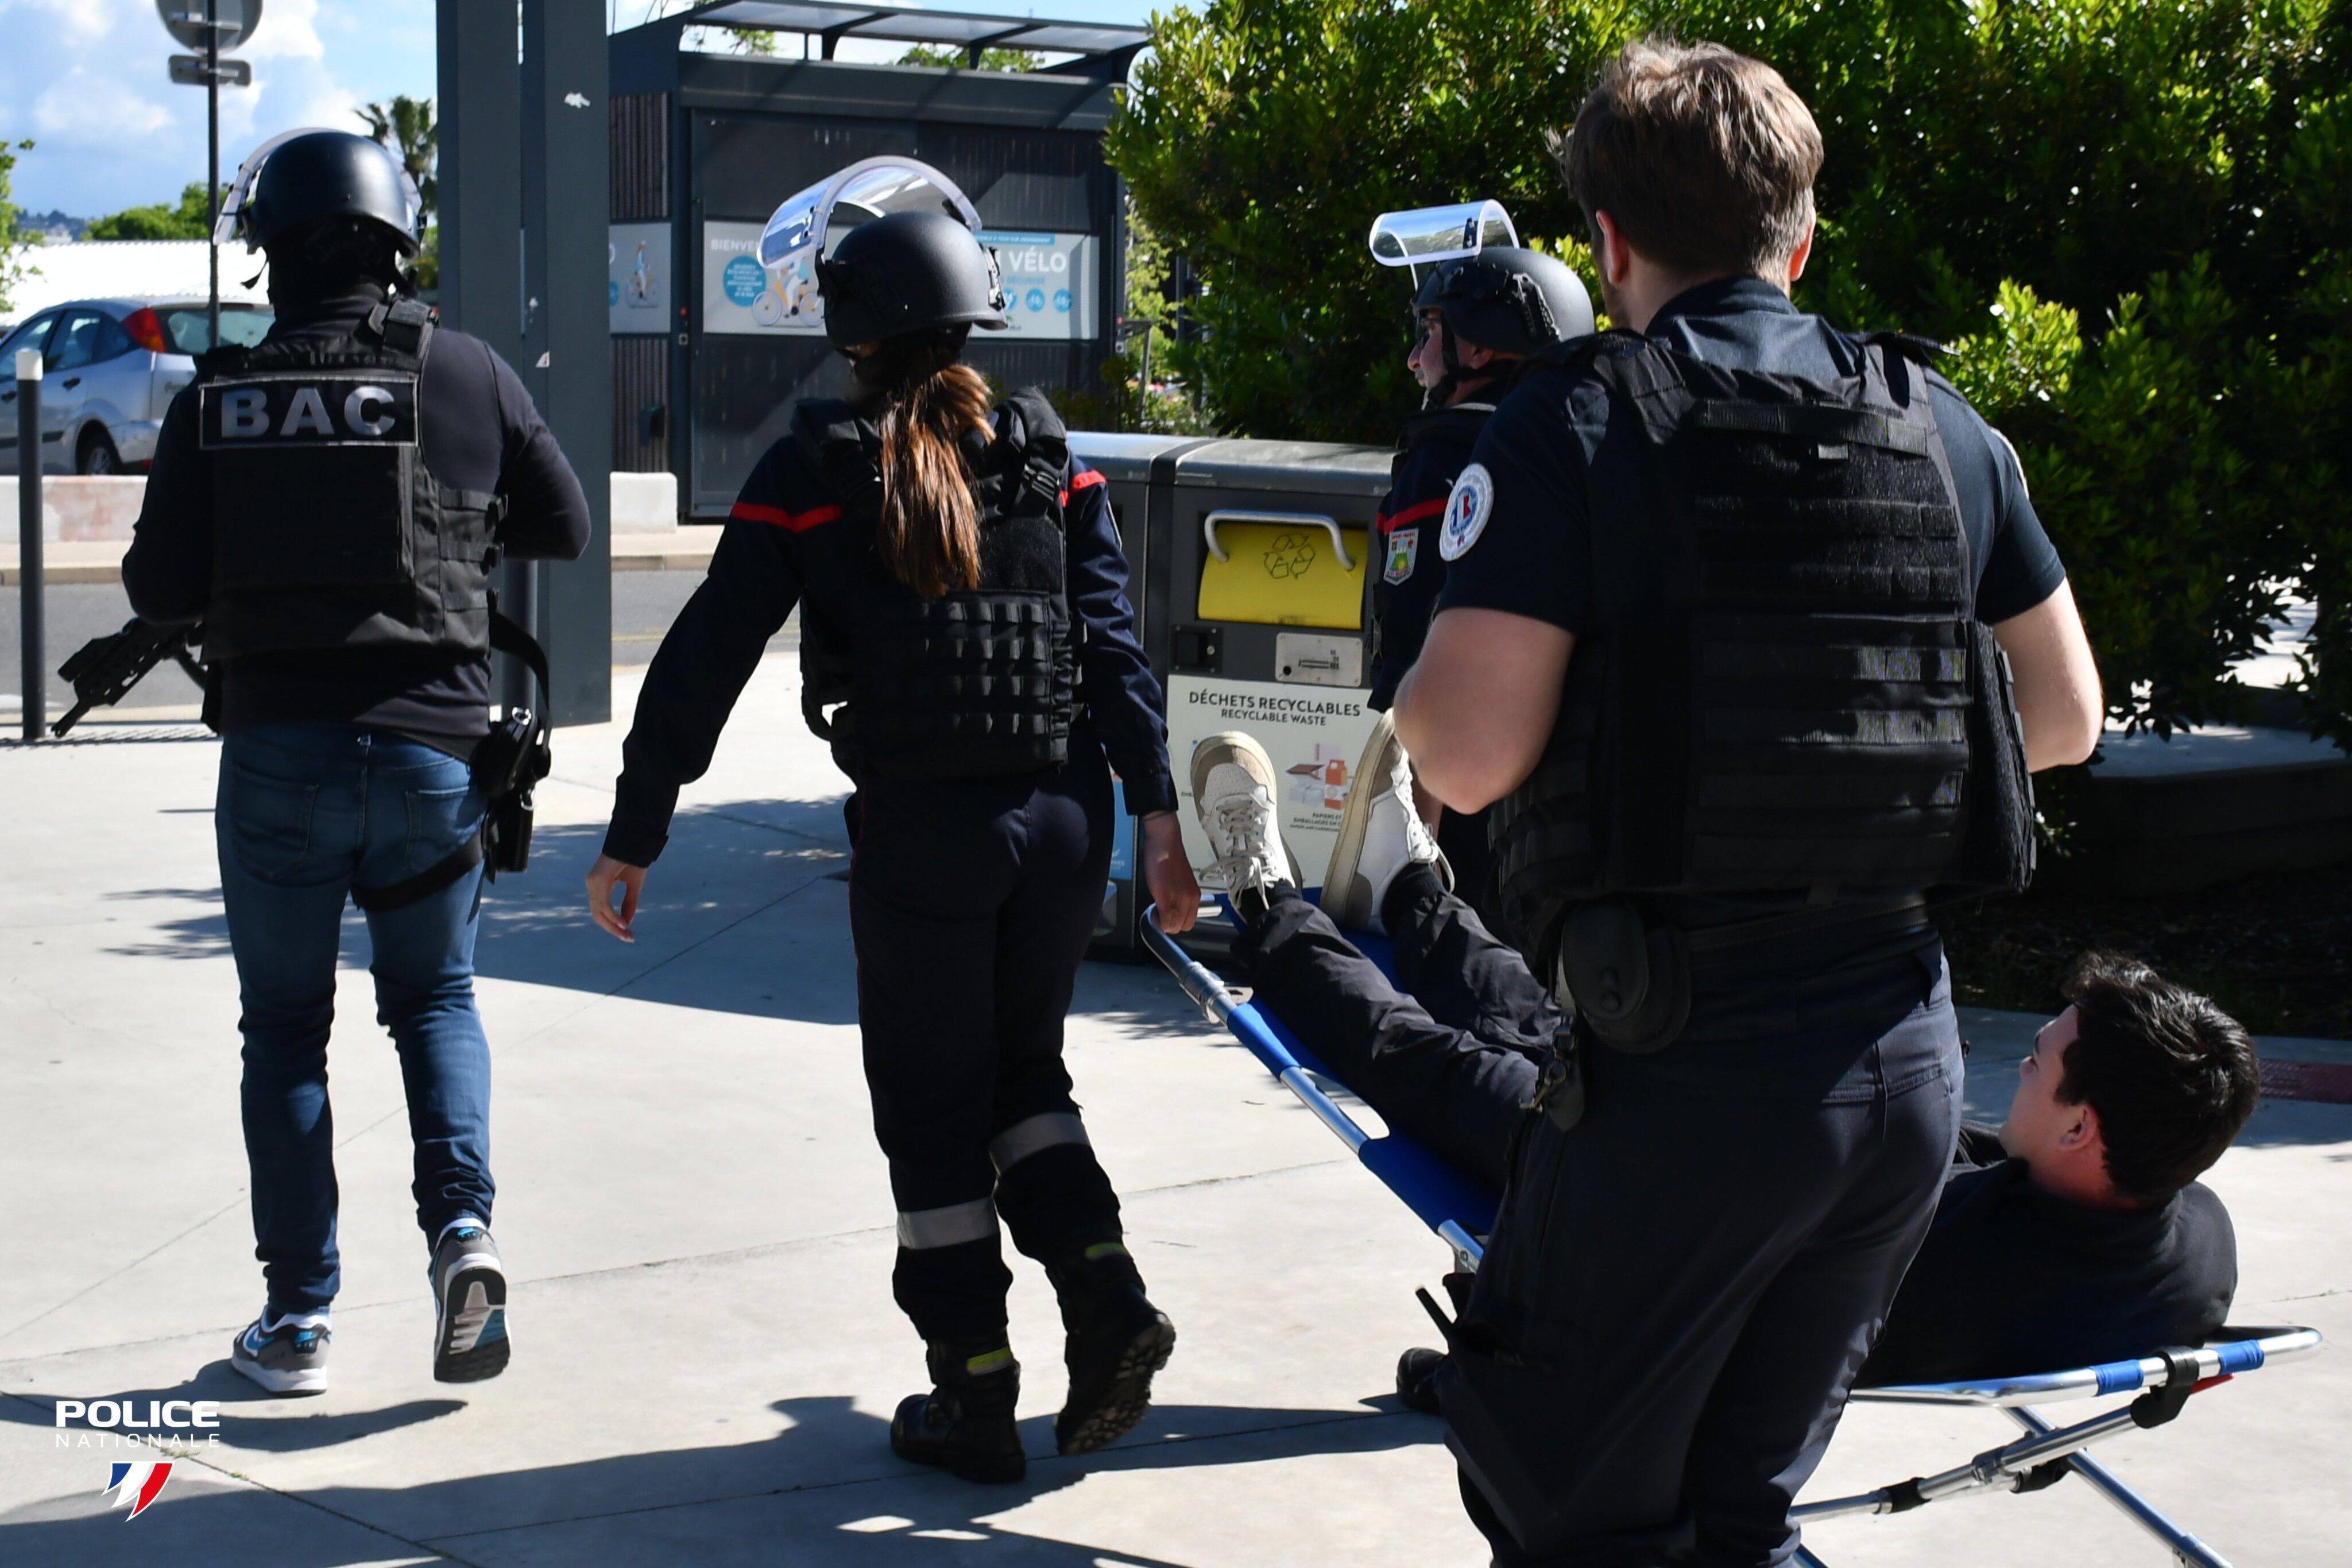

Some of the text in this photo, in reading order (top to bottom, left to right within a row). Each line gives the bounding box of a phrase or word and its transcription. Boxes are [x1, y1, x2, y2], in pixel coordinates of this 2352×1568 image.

[1008, 246, 1067, 273] VÉLO
[221, 385, 396, 438] BAC
[1189, 688, 1361, 717] DÉCHETS RECYCLABLES
[1221, 708, 1327, 726] RECYCLABLE WASTE
